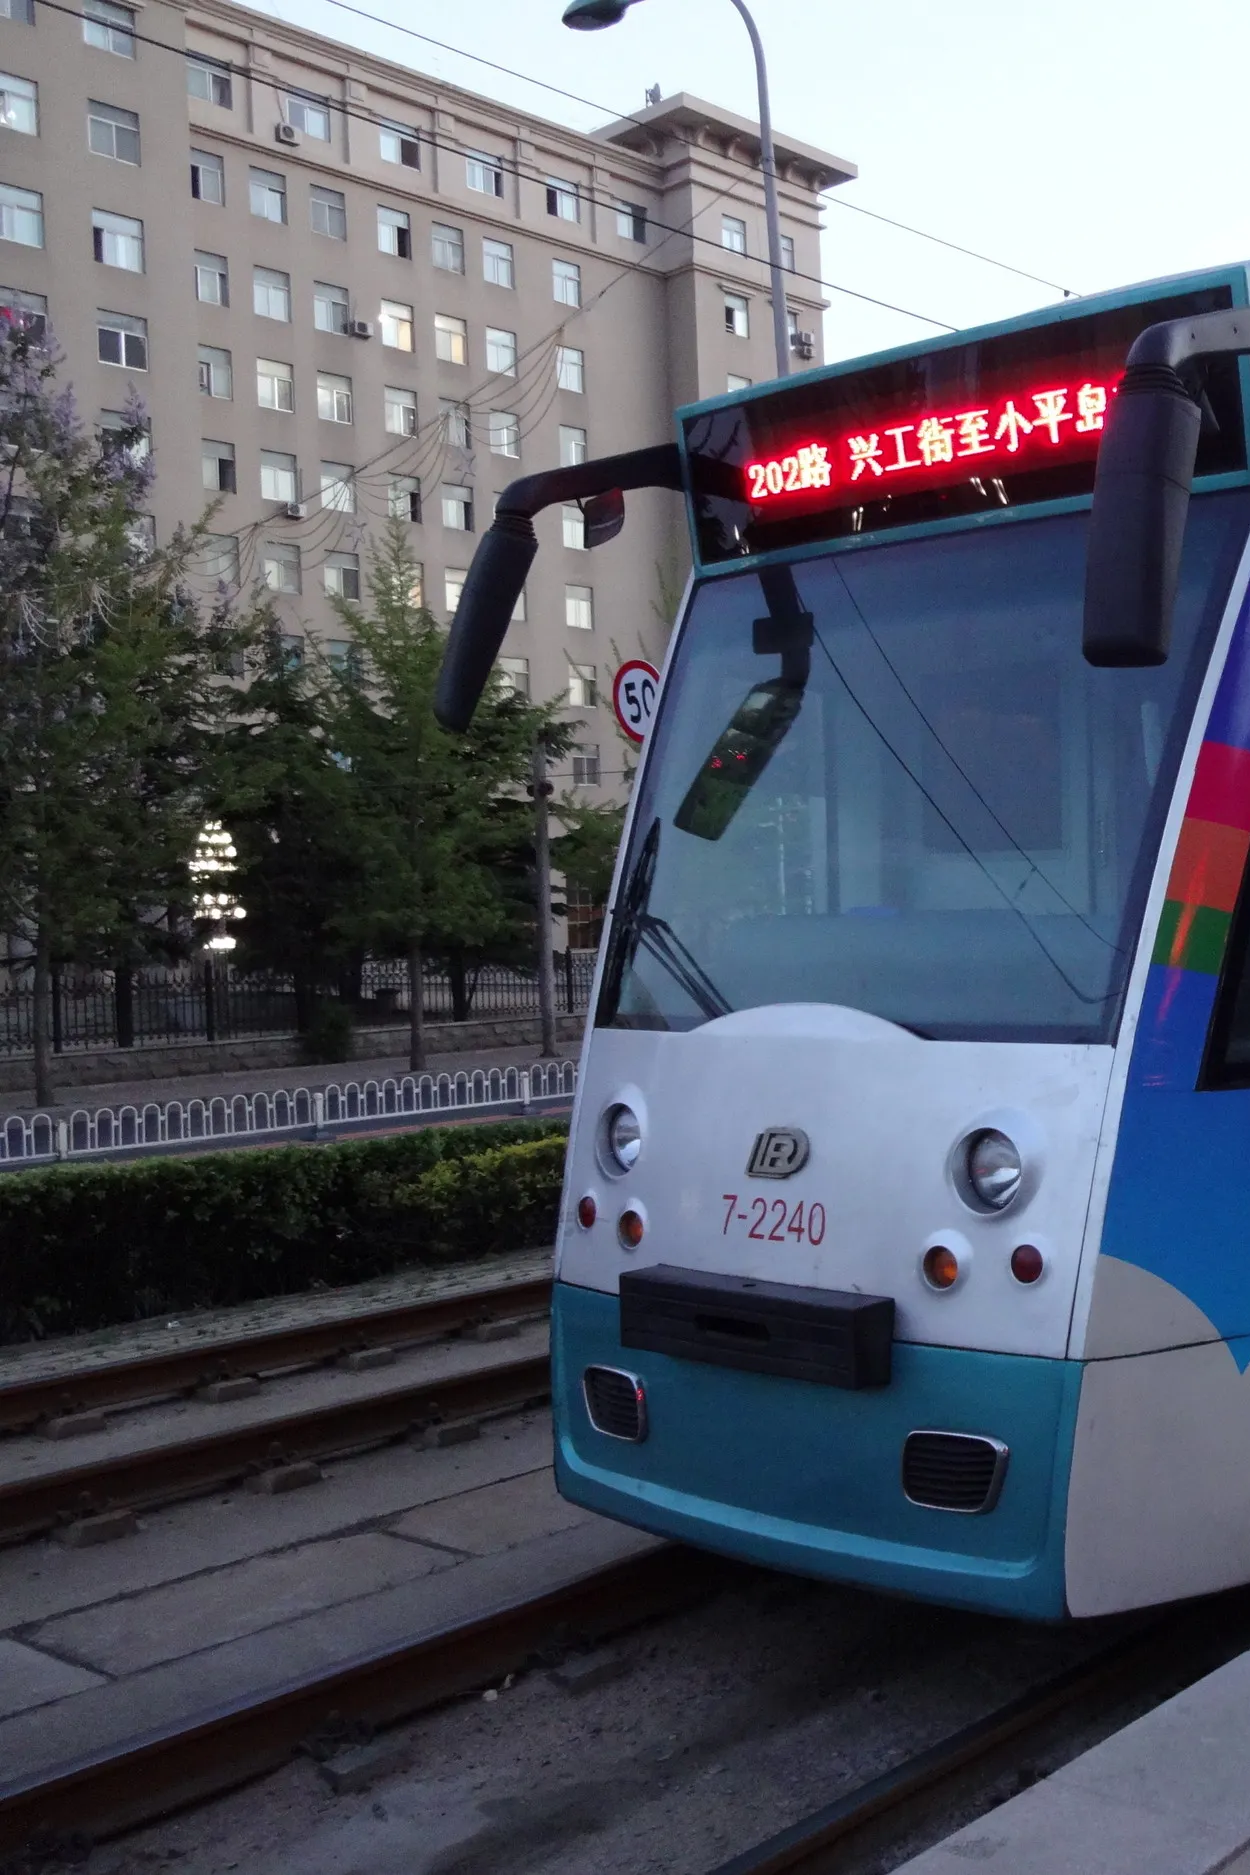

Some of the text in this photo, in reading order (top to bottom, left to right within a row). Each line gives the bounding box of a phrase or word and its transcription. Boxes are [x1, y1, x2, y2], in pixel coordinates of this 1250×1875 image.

[747, 383, 1118, 499] 202路 兴工街至小平岛
[624, 678, 656, 724] 50
[722, 1194, 826, 1246] 7-2240
